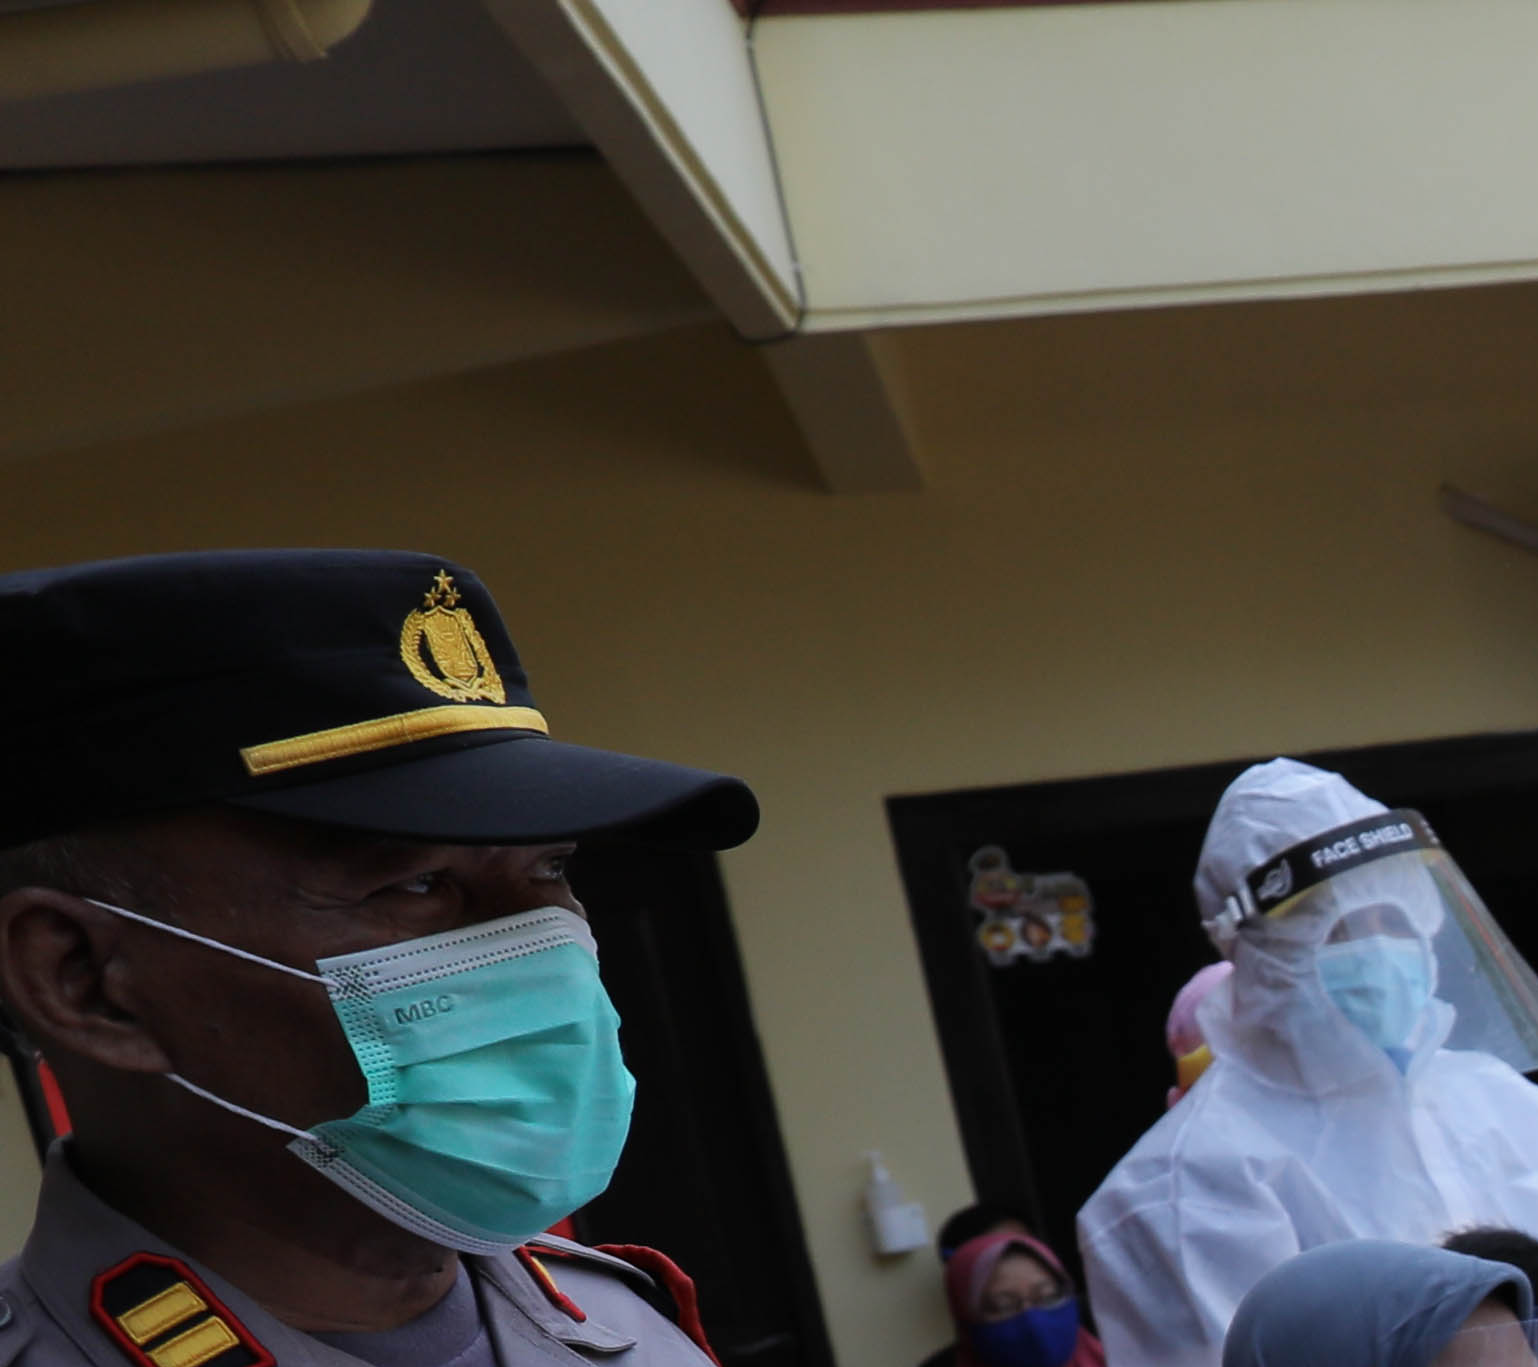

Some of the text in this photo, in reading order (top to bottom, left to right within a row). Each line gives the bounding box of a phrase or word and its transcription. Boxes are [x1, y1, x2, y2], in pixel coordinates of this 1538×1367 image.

[1311, 822, 1414, 868] FACE SHIELD
[394, 994, 455, 1025] MBC
